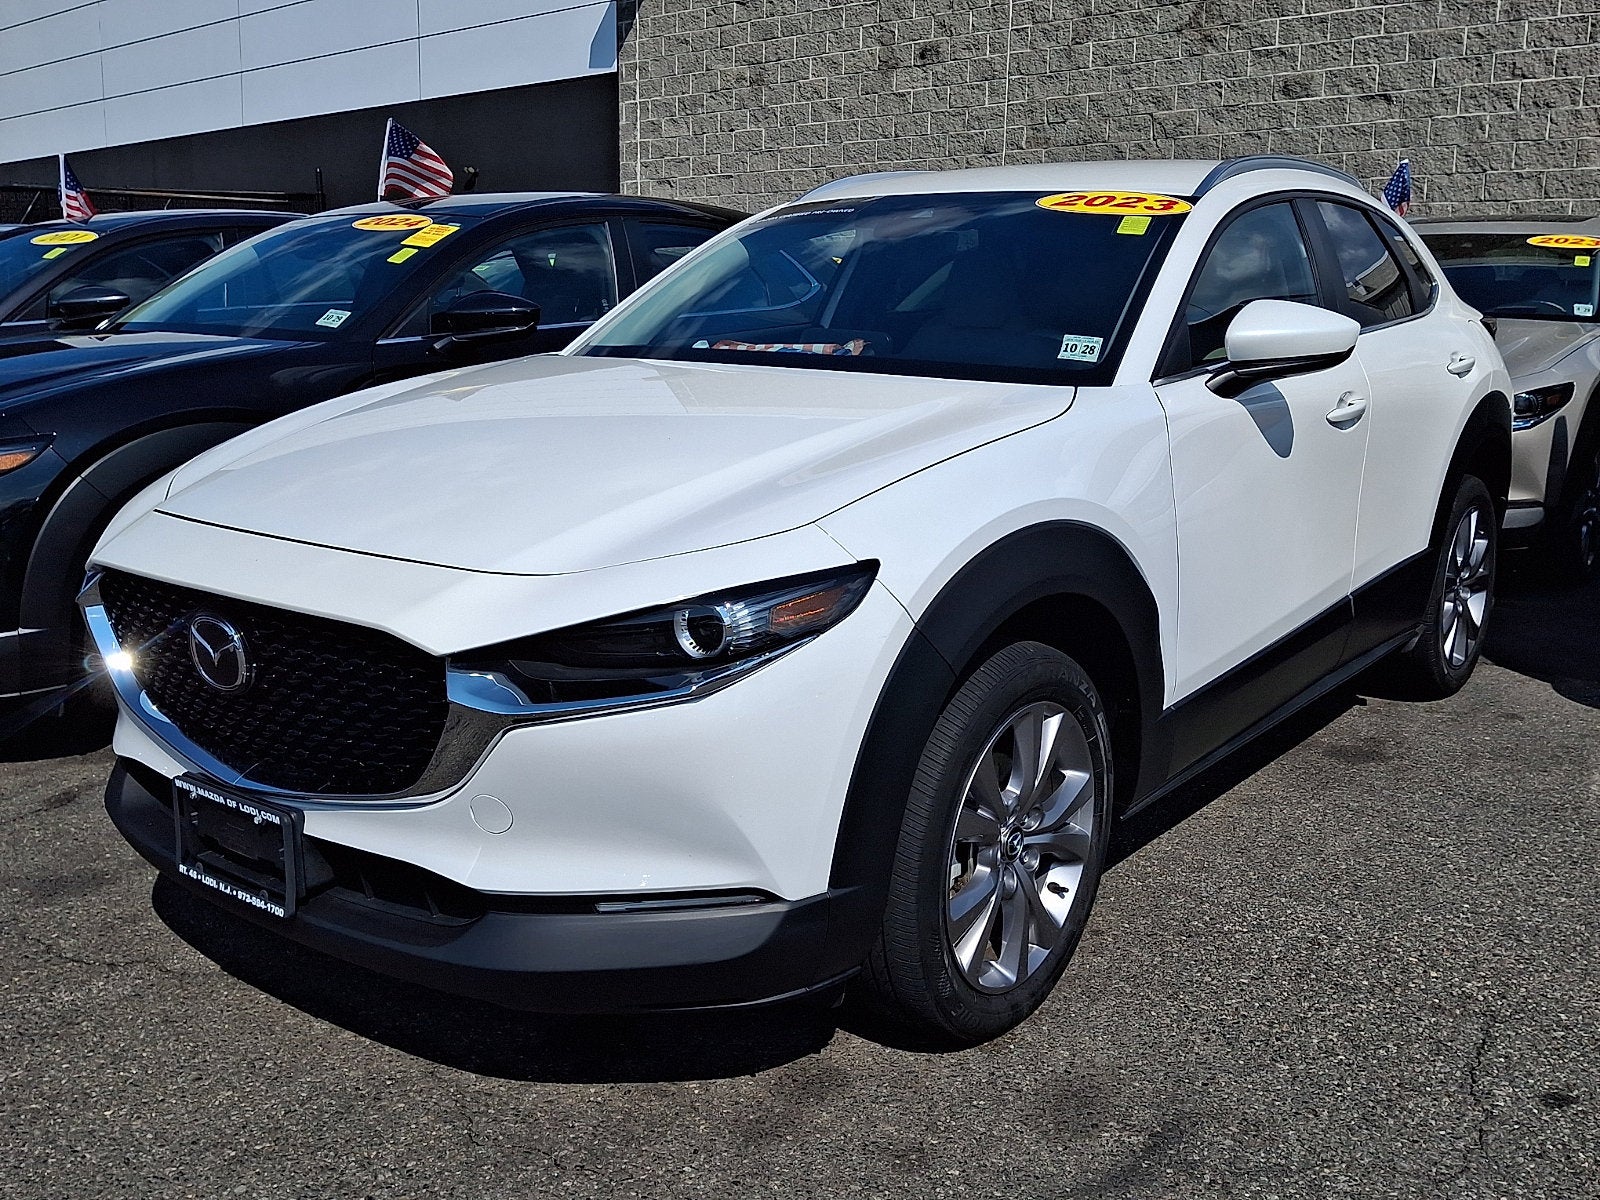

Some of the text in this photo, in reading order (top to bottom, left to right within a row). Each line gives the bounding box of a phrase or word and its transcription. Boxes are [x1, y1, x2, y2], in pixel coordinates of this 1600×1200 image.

[1050, 195, 1179, 211] 2023
[357, 217, 427, 228] 2024
[1536, 237, 1600, 246] 2023
[1063, 342, 1096, 355] 10 28
[174, 778, 281, 825] WWW.MAZDA OF LODI.COM
